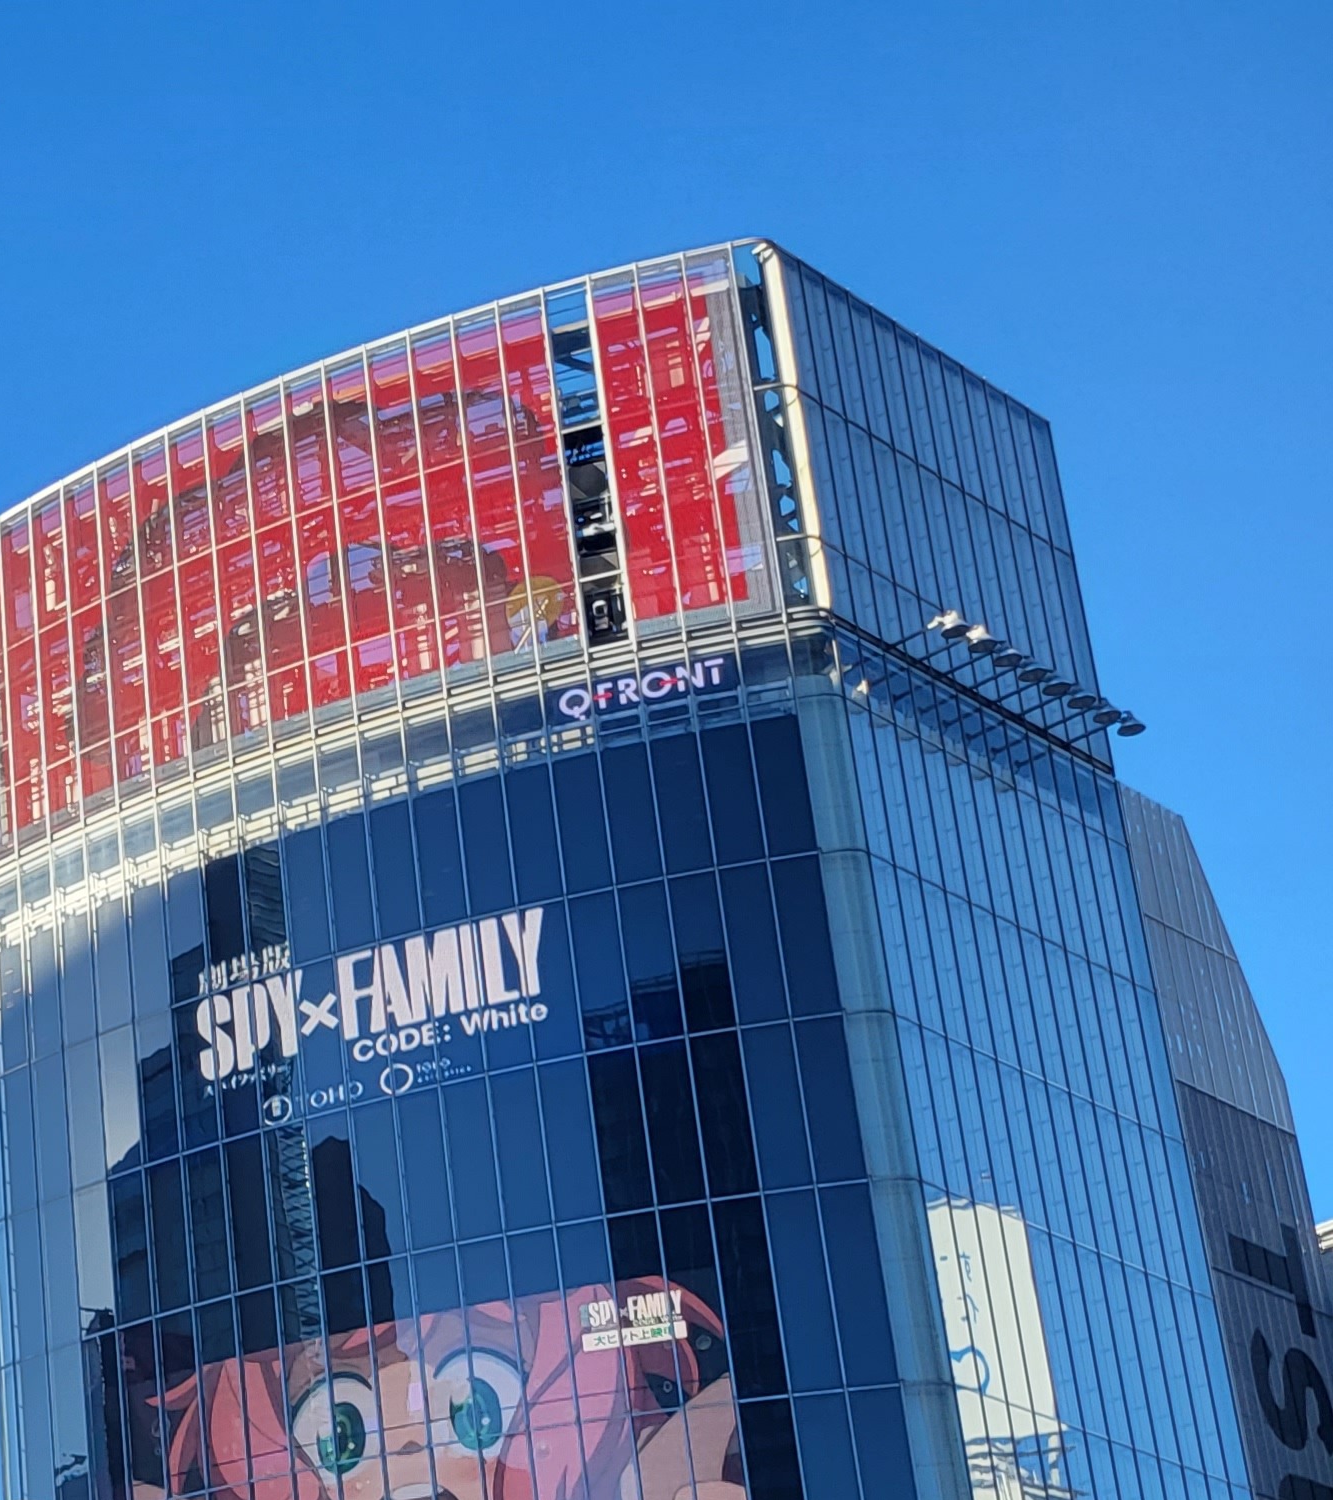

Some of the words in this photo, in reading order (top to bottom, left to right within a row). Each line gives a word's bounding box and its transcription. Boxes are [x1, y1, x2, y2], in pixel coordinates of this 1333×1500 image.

[558, 657, 725, 721] QFRONT
[199, 942, 290, 994] 劇場版
[352, 1022, 452, 1063] CODE:
[459, 1001, 549, 1037] White
